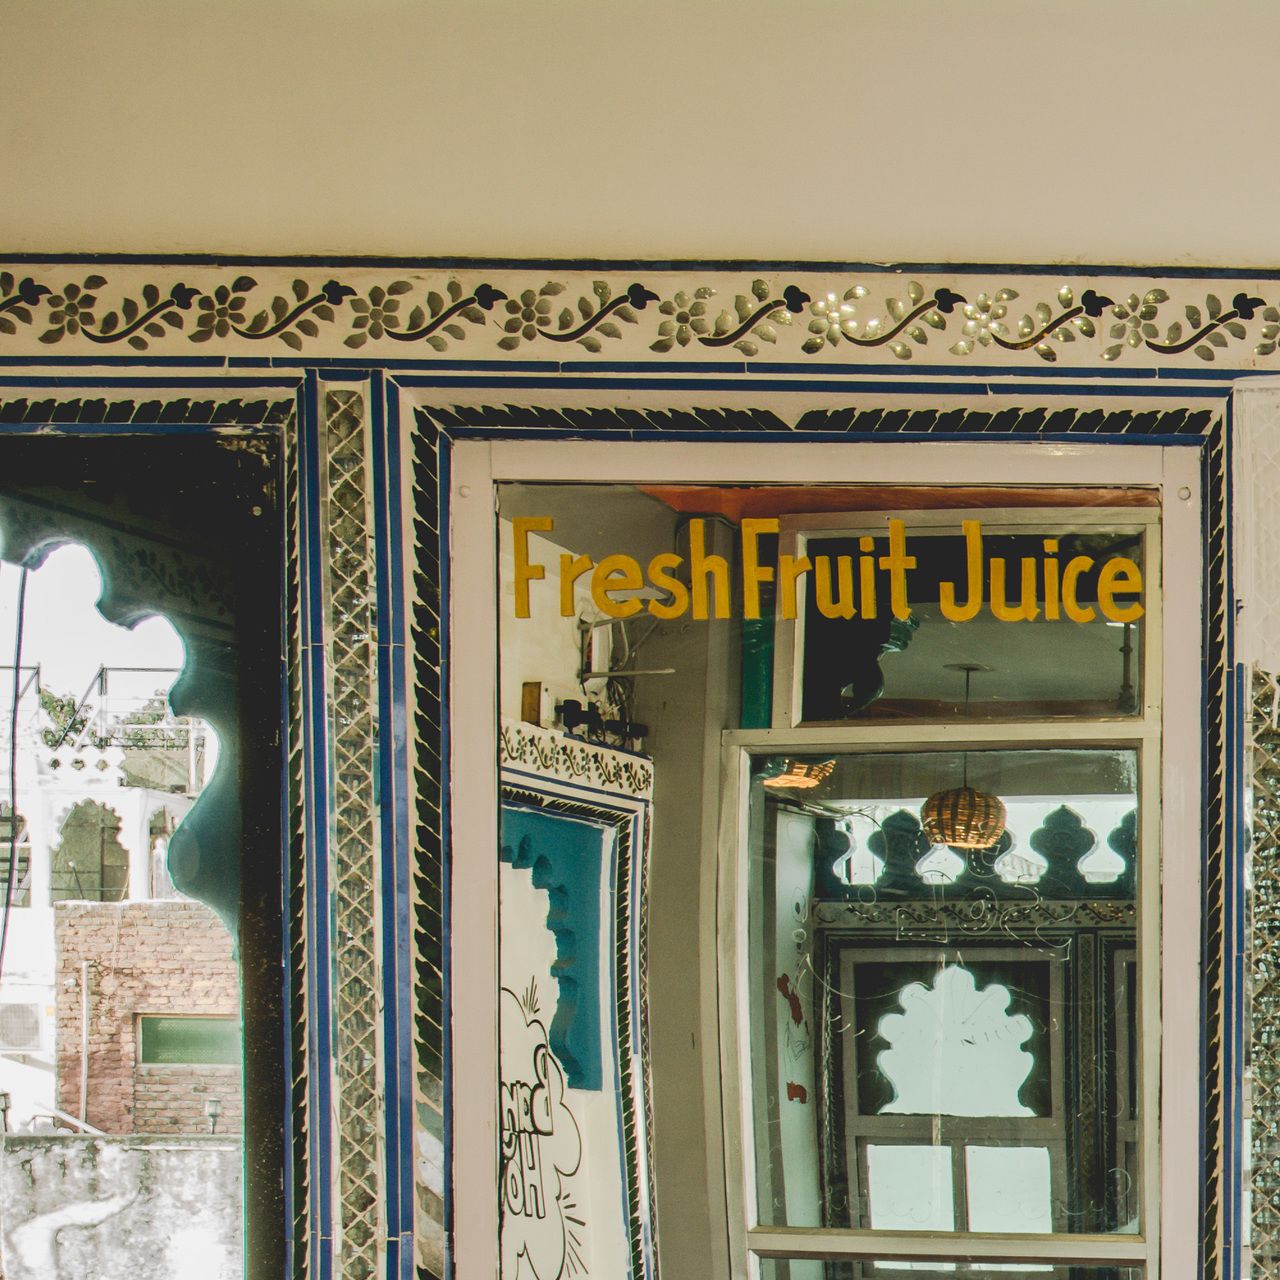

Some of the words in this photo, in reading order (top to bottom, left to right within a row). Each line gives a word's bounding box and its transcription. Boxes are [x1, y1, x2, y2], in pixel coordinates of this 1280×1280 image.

[512, 516, 730, 621] Fresh
[741, 517, 917, 621] Fruit
[939, 519, 1145, 624] Juice
